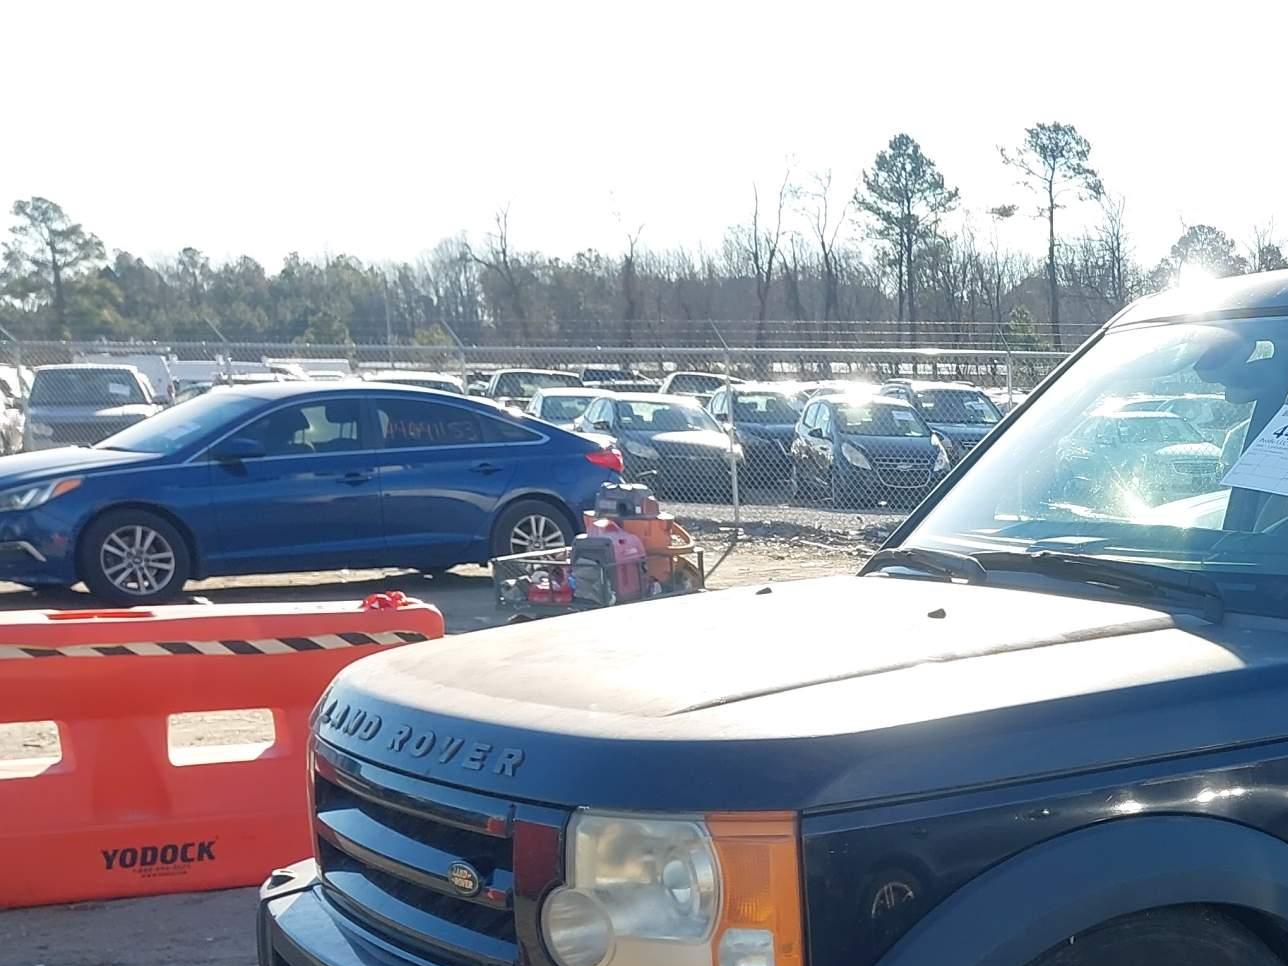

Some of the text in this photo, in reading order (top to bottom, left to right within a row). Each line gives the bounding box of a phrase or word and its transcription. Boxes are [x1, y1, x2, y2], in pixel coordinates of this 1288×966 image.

[320, 699, 526, 777] LAND ROVER
[101, 840, 216, 870] YODOCK
